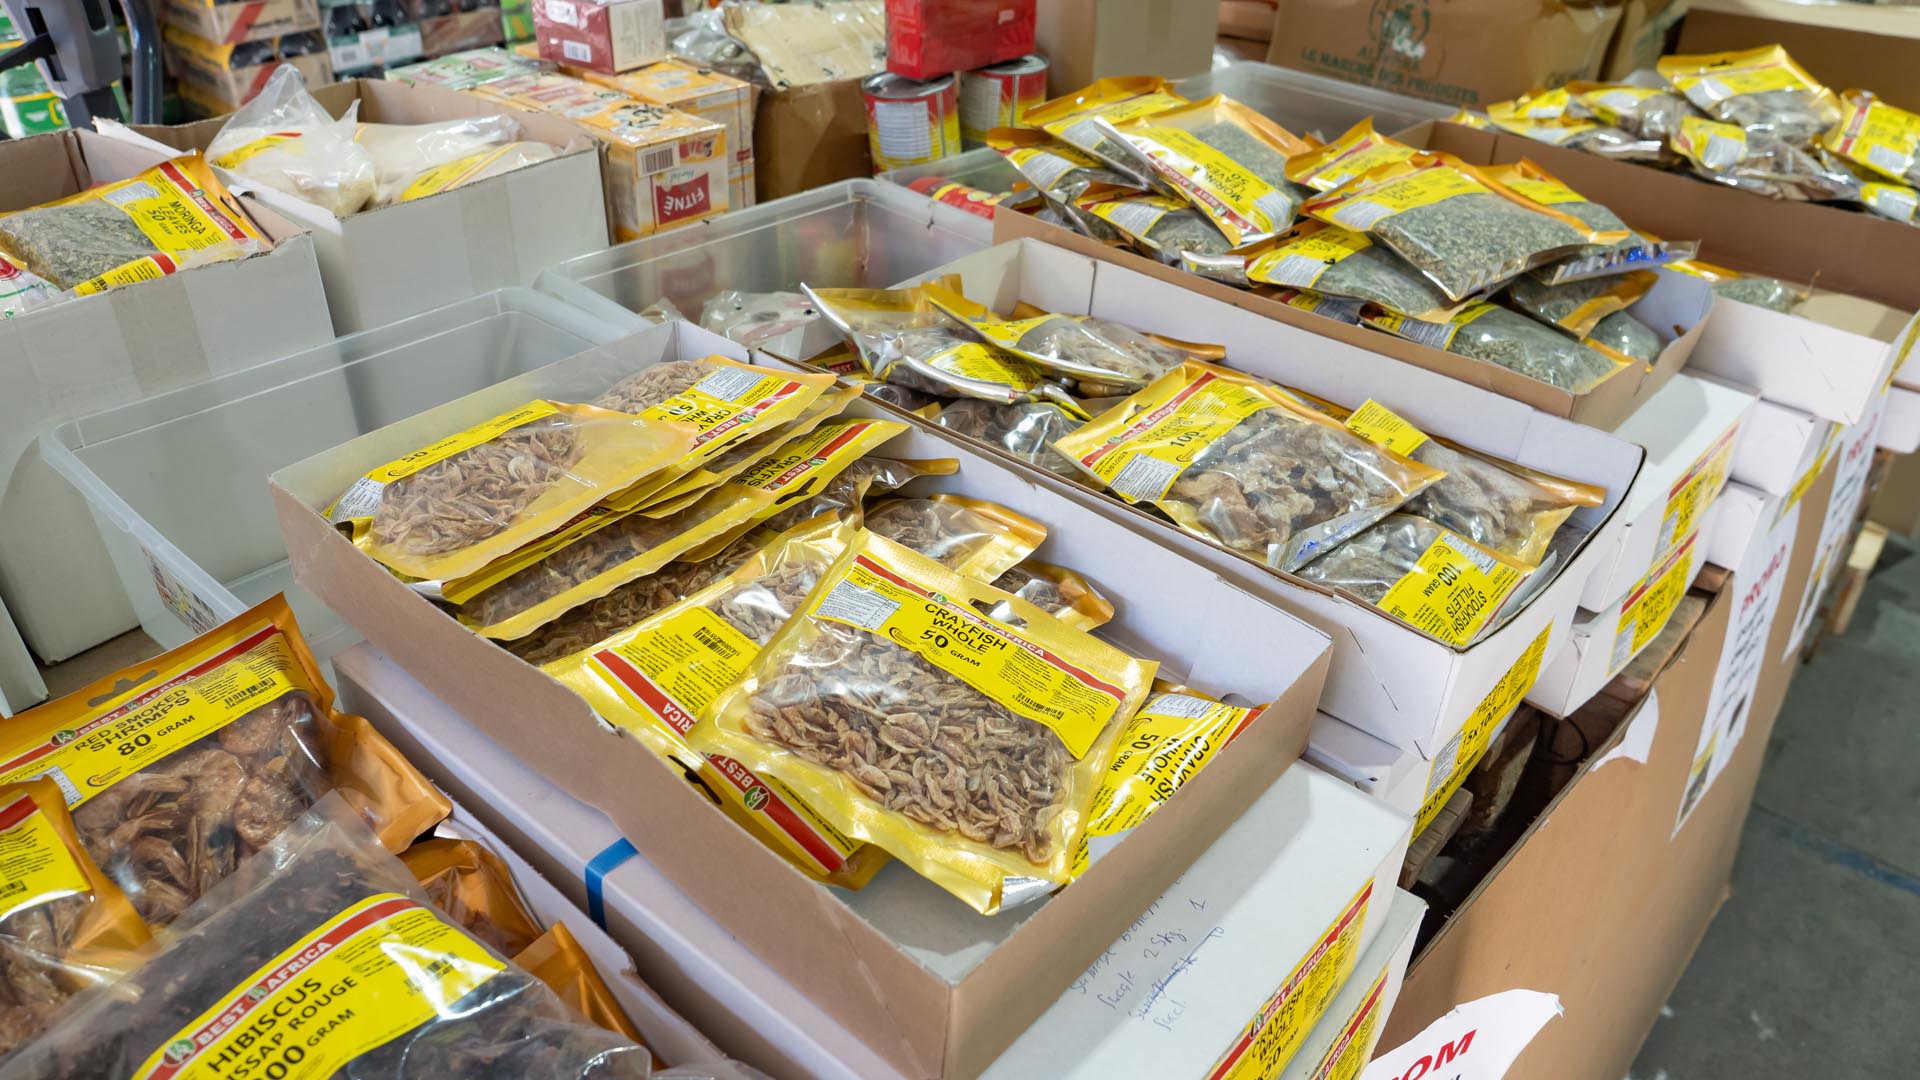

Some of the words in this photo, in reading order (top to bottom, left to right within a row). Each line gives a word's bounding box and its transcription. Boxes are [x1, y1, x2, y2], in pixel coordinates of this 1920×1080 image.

[168, 200, 208, 236] MORINGA
[698, 409, 732, 434] CRAY
[708, 420, 740, 437] BEST
[1169, 430, 1201, 449] 100
[780, 461, 809, 483] BEST
[1423, 579, 1441, 598] GRAM
[1437, 562, 1462, 587] 100
[1445, 582, 1476, 620] FILLETS
[1451, 590, 1487, 637] STOCKFISH
[923, 602, 1008, 651] CRAYFISH
[931, 617, 990, 655] WHOLE
[996, 625, 1046, 658] AFRICA
[920, 628, 949, 650] 50
[950, 648, 982, 668] GRAM
[74, 729, 111, 752] RED
[115, 688, 189, 731] SMOKED
[79, 711, 122, 737] BEST
[91, 694, 191, 753] SHRIMPS
[117, 732, 152, 758] 80
[156, 714, 195, 738] GRAM
[1110, 749, 1134, 773] GRAM
[1131, 733, 1161, 750] 50
[1140, 736, 1184, 786] WHOLE
[717, 757, 755, 789] BEST
[1149, 734, 1210, 807] CRAYFISH
[197, 1005, 246, 1047] BEST
[265, 941, 334, 993] AFRICA
[287, 976, 358, 1031] ROUGE
[206, 977, 323, 1073] HIBISCUS
[1251, 985, 1305, 1060] CRAYFISH
[255, 1044, 306, 1080] 00
[306, 1008, 356, 1048] GRAM
[1324, 1032, 1352, 1074] AFRICA
[1391, 1028, 1478, 1080] OM
